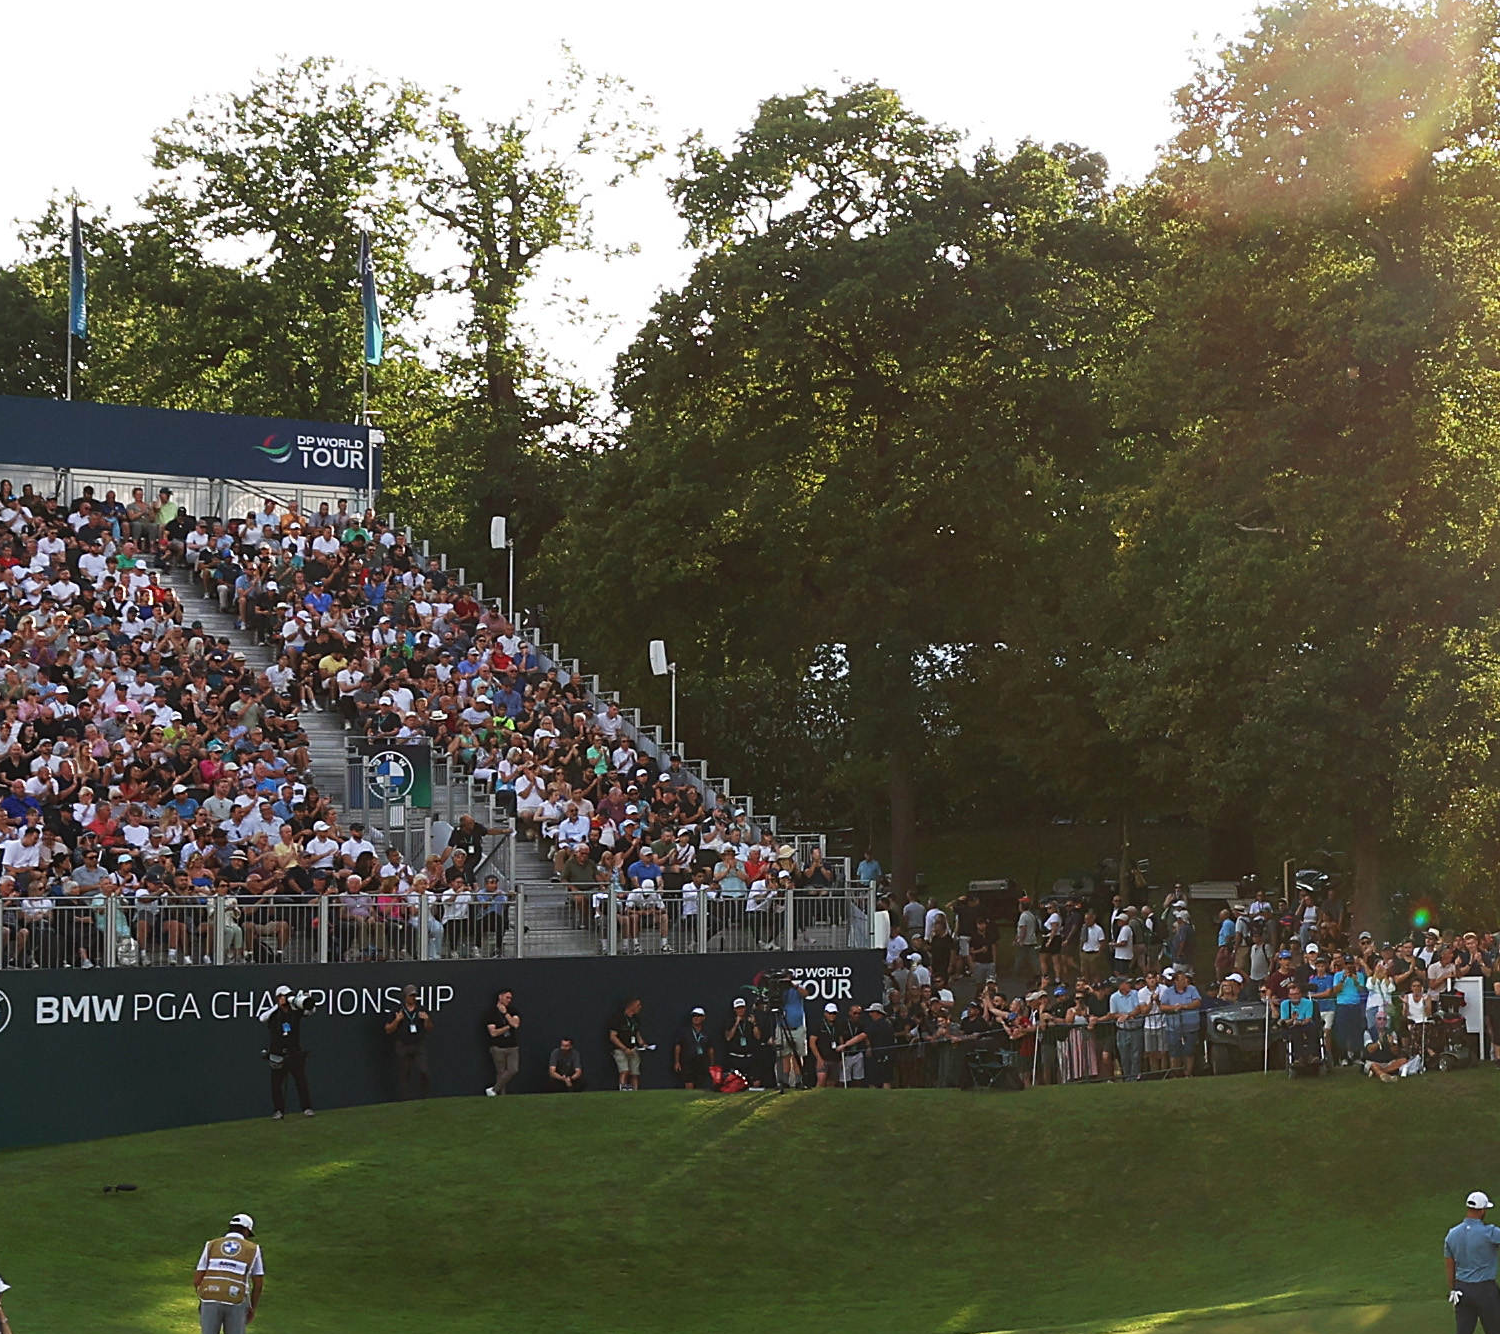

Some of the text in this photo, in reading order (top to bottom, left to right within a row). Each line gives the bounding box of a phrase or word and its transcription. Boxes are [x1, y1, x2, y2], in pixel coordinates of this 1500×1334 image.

[297, 435, 364, 449] DP WORLD
[298, 446, 365, 469] TOUR
[373, 754, 407, 767] BMW
[805, 967, 851, 978] WORLD
[36, 985, 454, 1024] BMW PGA CHAPIONSHIP
